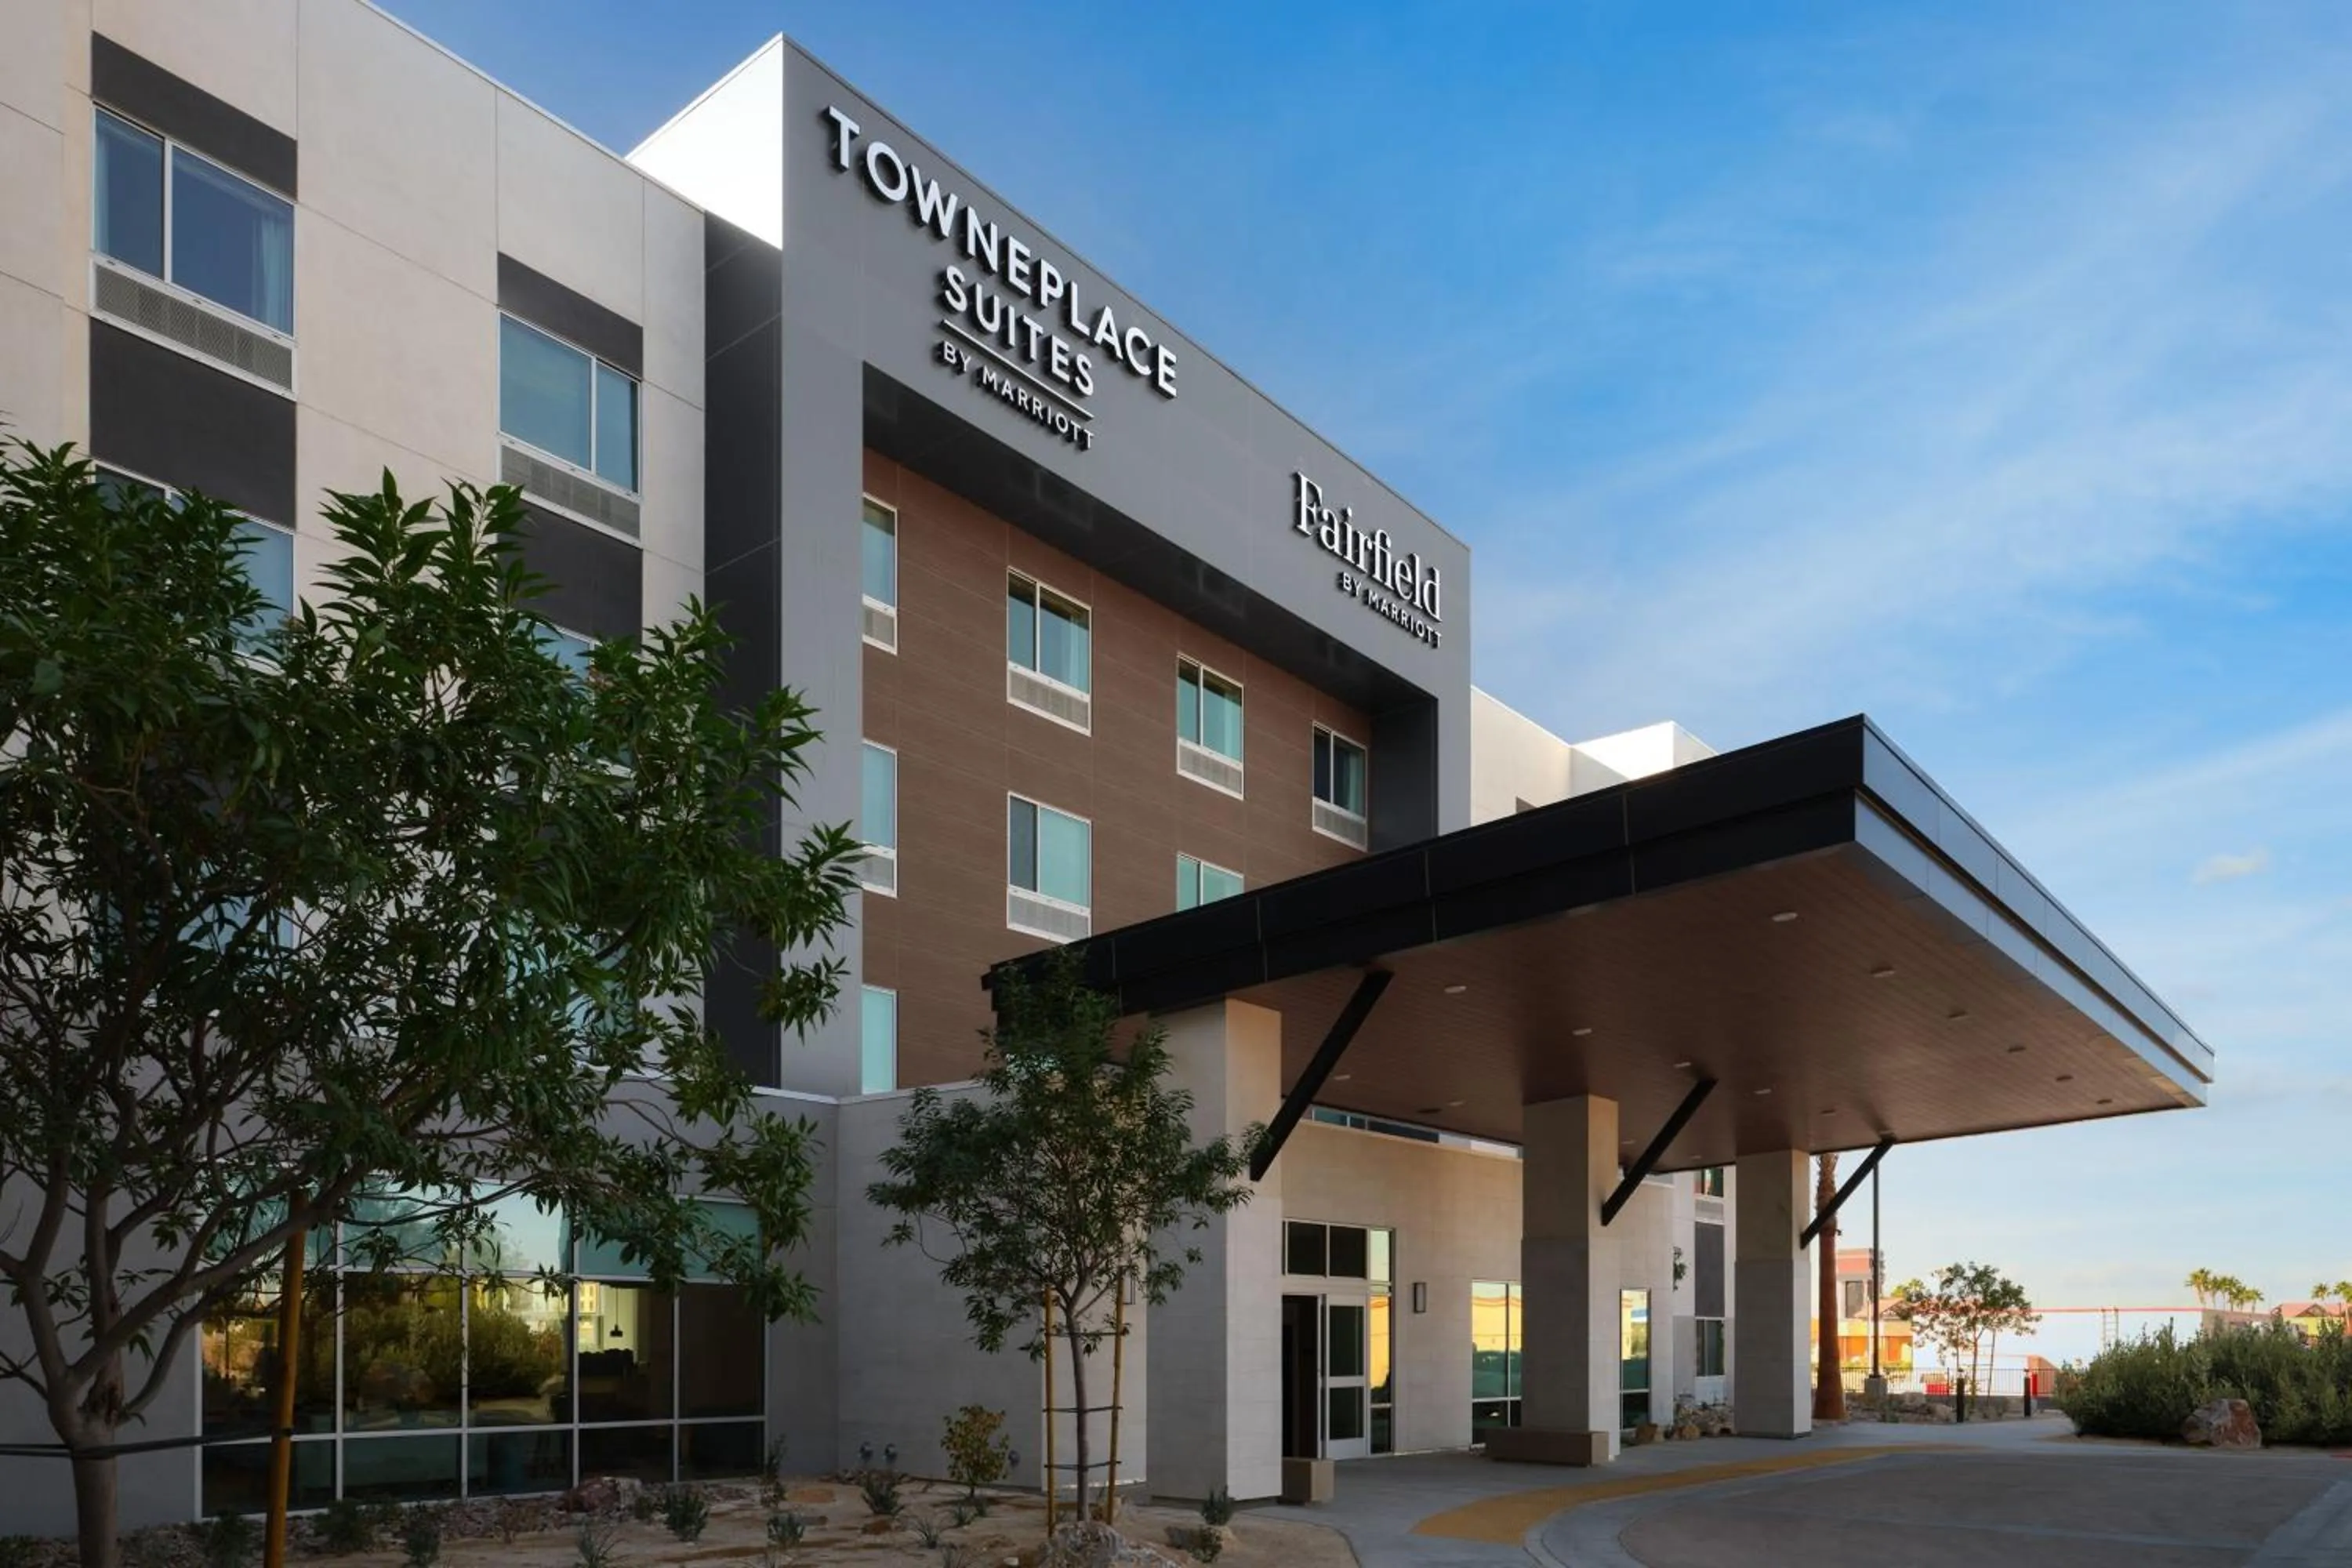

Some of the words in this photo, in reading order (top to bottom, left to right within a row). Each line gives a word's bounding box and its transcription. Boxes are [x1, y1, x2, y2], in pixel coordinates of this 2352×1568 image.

[826, 105, 1178, 398] TOWNEPLACE
[941, 339, 971, 373] BY
[981, 364, 1094, 450] MARRIOTT
[942, 264, 1094, 397] SUITES
[1295, 470, 1443, 622] Fairfield
[1341, 572, 1362, 597] BY
[1367, 589, 1443, 648] MARRIOTT
